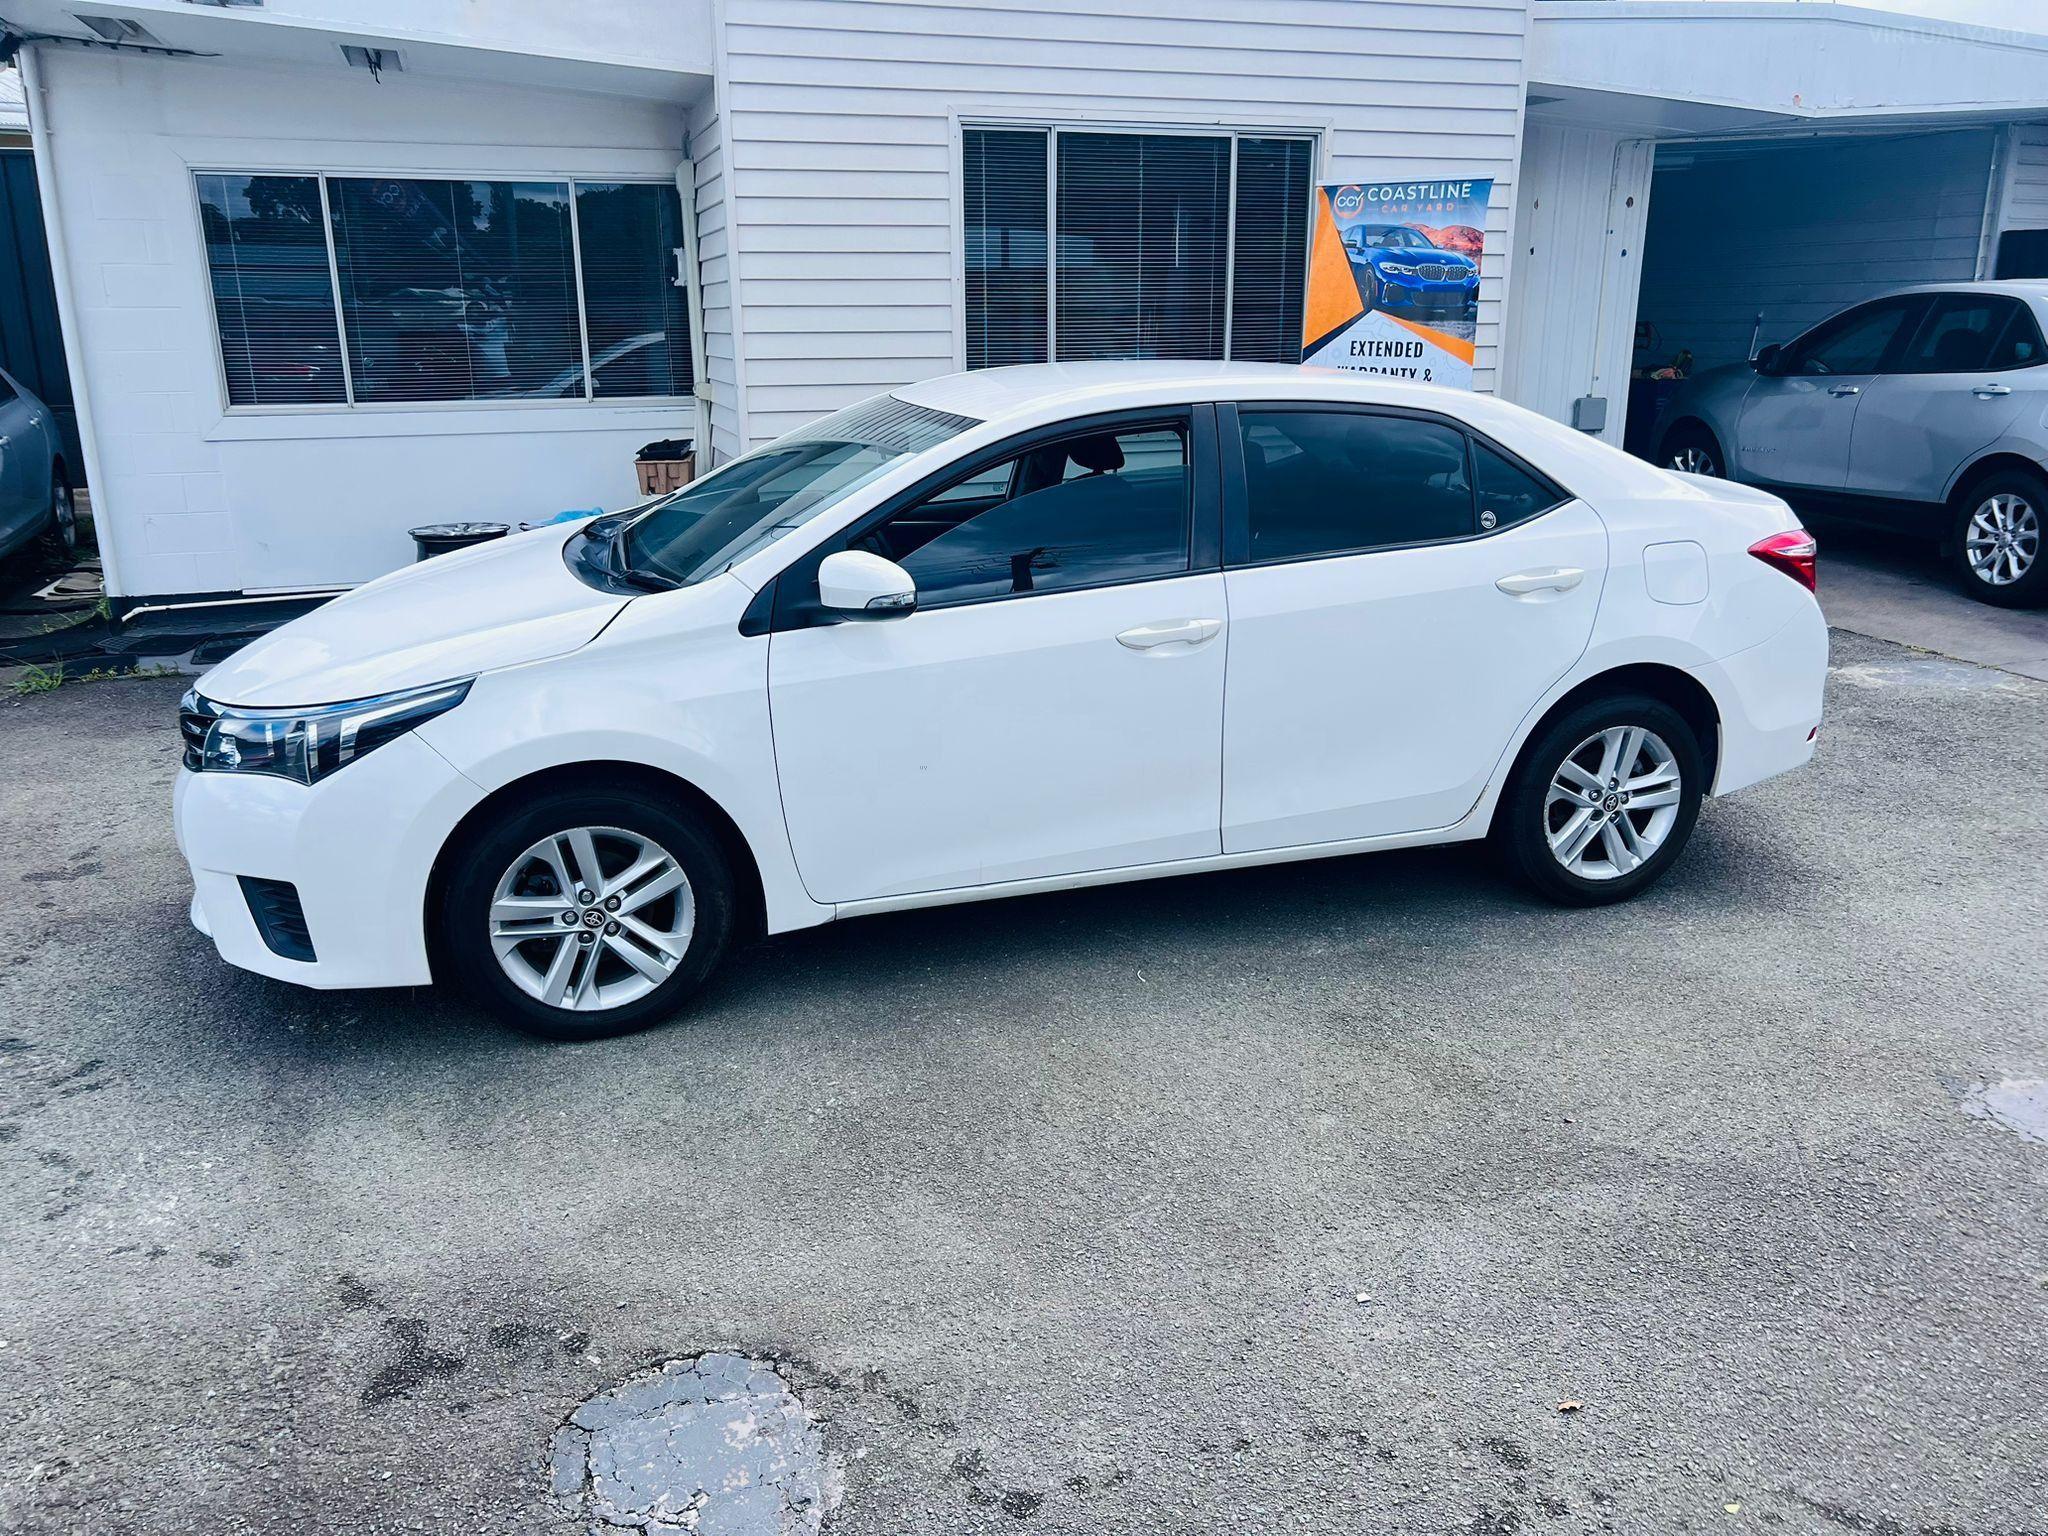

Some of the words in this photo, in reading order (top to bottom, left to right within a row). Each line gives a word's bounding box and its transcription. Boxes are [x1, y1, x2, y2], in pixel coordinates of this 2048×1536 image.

[1337, 192, 1364, 208] CCY
[1367, 183, 1472, 201] COASTLINE
[1381, 204, 1409, 213] CAR
[1416, 203, 1455, 212] YARD
[1350, 340, 1424, 358] EXTENDED
